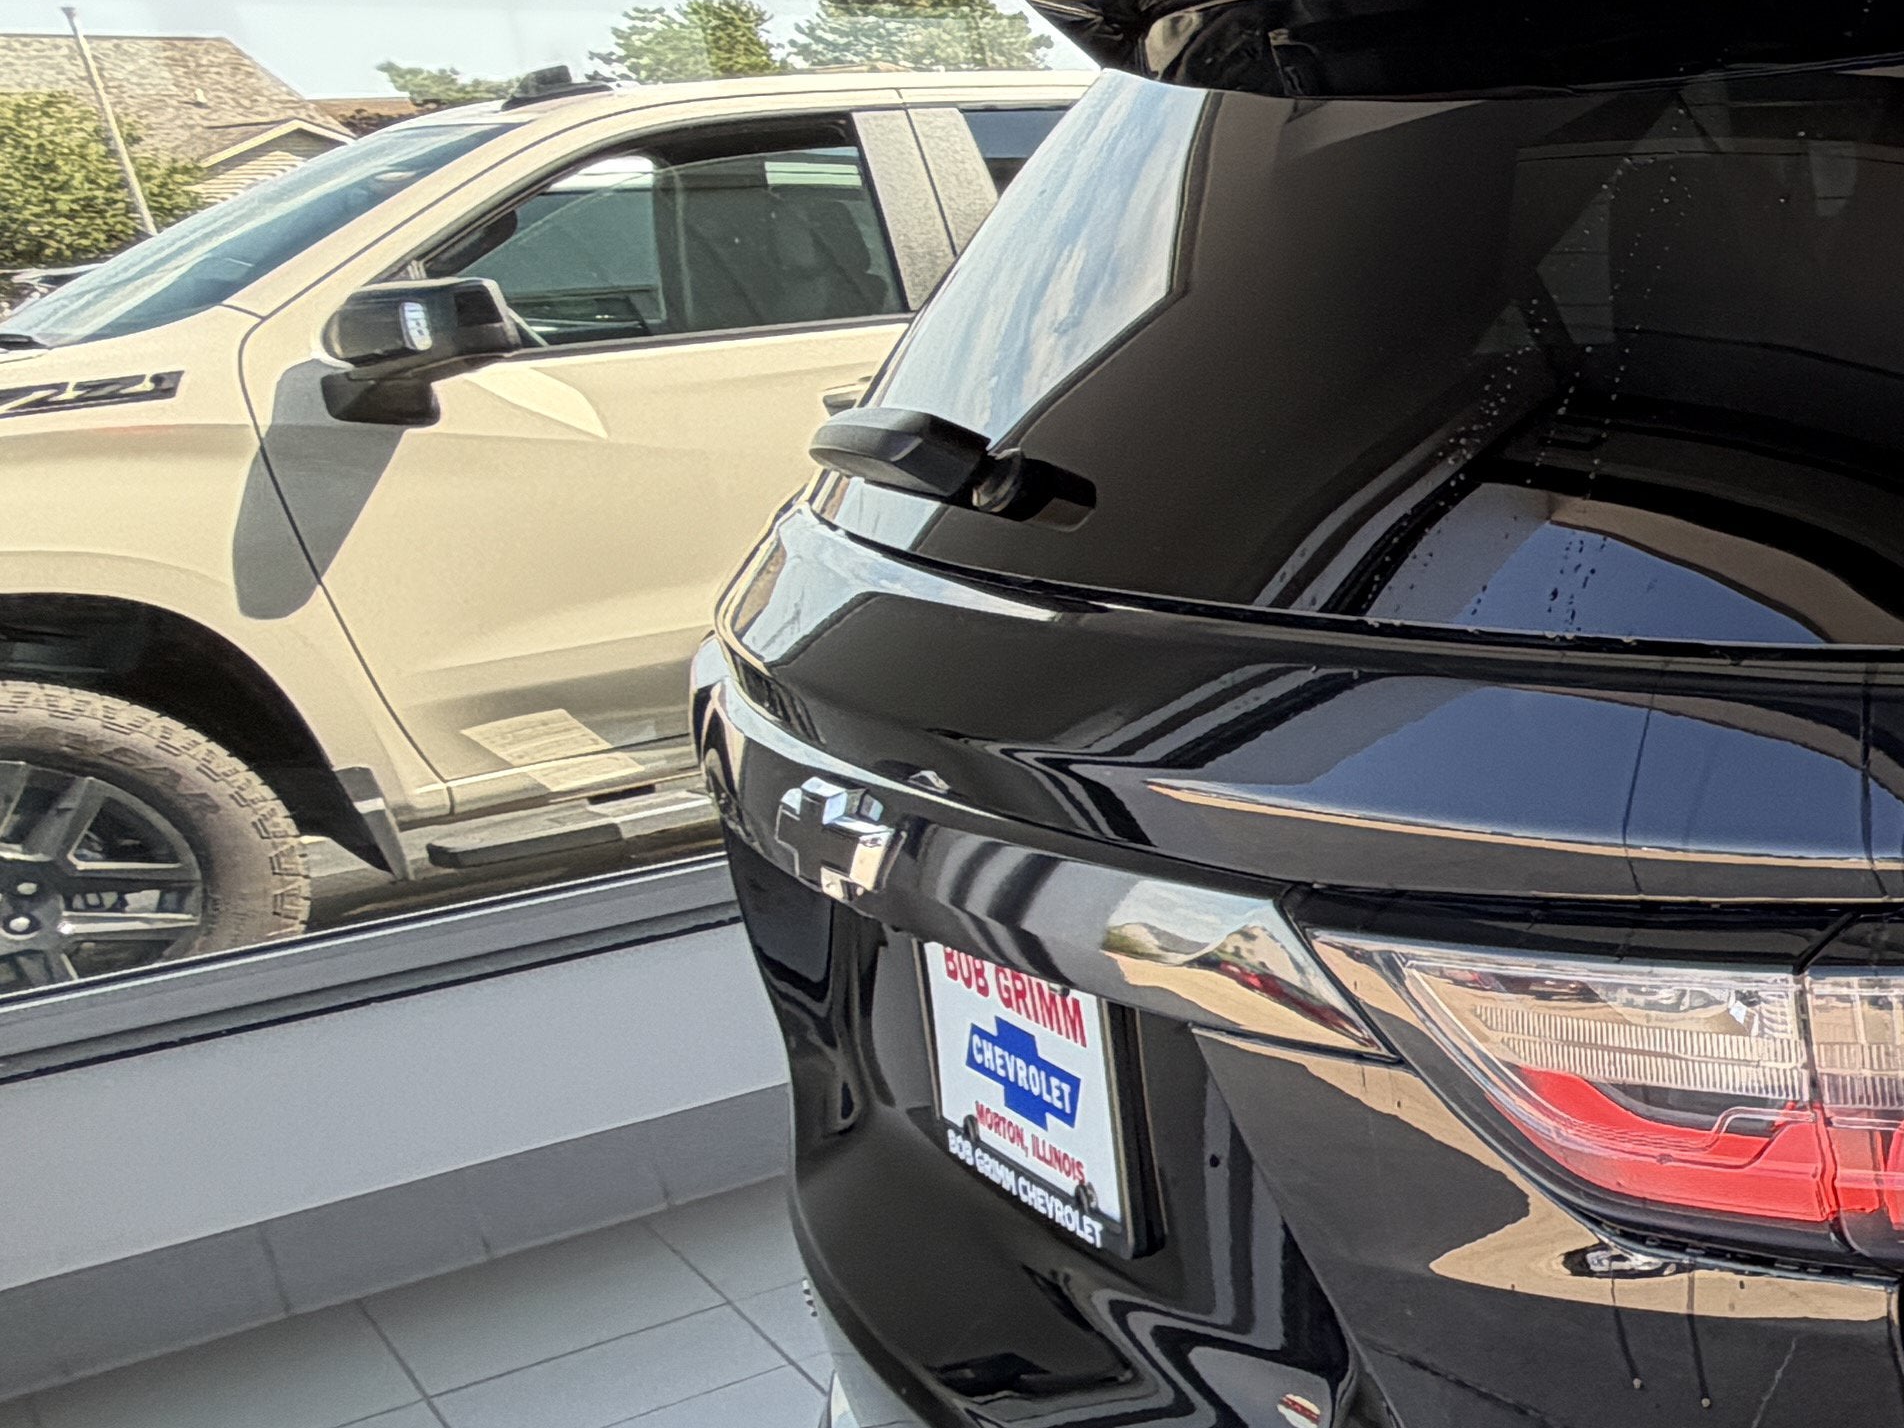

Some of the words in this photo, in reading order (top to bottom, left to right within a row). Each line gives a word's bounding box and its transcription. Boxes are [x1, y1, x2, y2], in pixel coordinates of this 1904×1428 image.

[943, 945, 990, 999] BOB
[995, 963, 1089, 1049] GRIMM
[971, 1033, 1073, 1115] CHEVROLET
[947, 1128, 974, 1167] BOB
[973, 1147, 1018, 1197] GRIMM
[1017, 1175, 1104, 1249] CHEVROLET
[974, 1100, 1030, 1159] MORTON,
[1031, 1132, 1086, 1186] ILLINOIS
